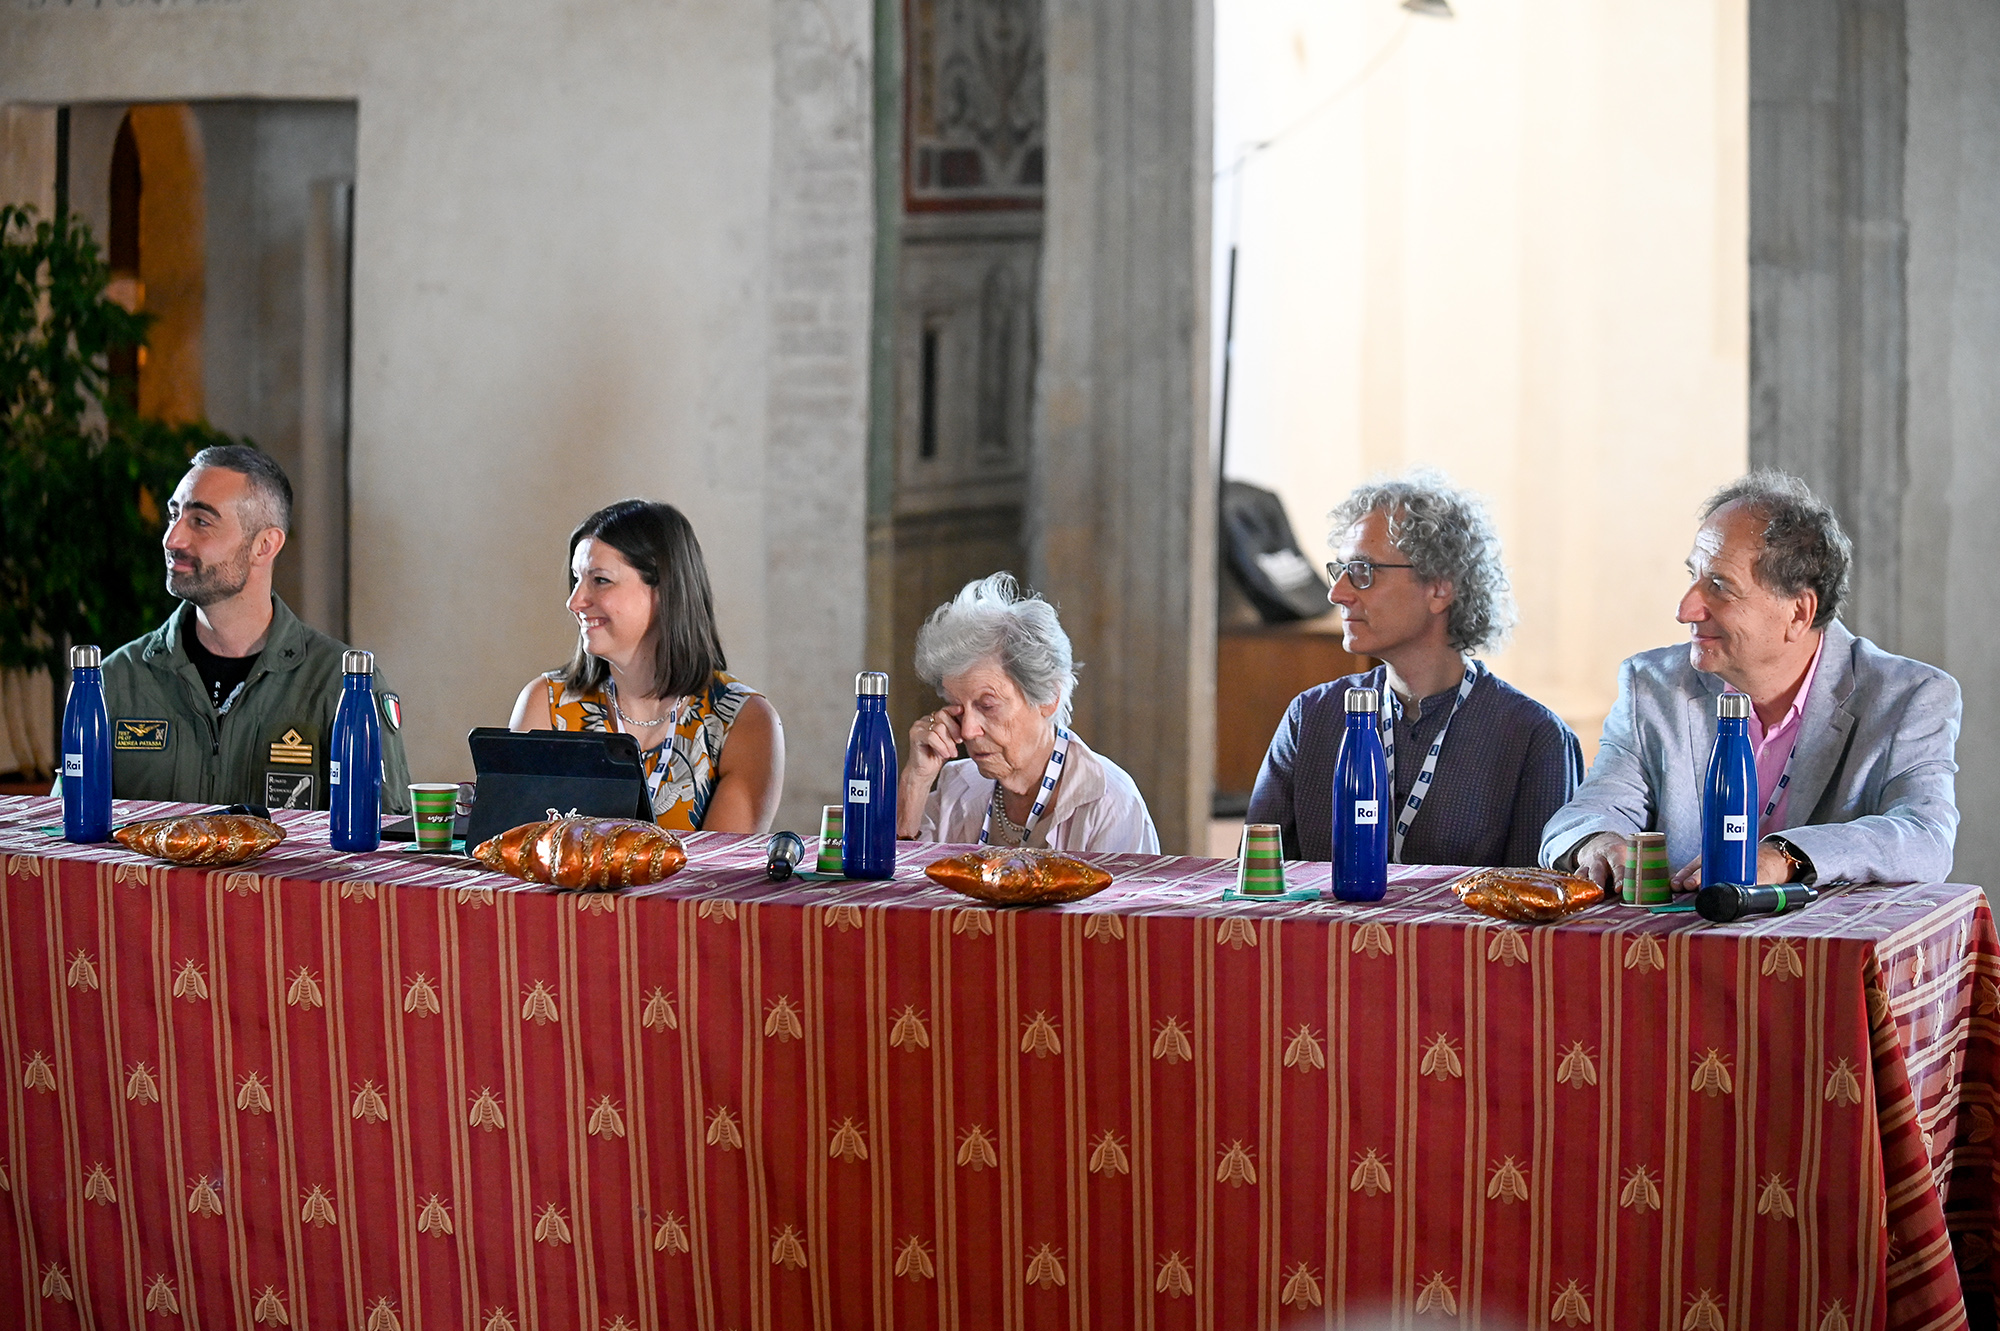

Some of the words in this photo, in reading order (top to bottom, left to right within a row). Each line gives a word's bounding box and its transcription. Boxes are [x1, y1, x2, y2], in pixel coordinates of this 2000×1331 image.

[66, 760, 81, 771] Rai
[330, 767, 339, 778] ai
[850, 786, 868, 797] Rai
[1357, 806, 1377, 818] Rai
[1726, 822, 1745, 834] Rai
